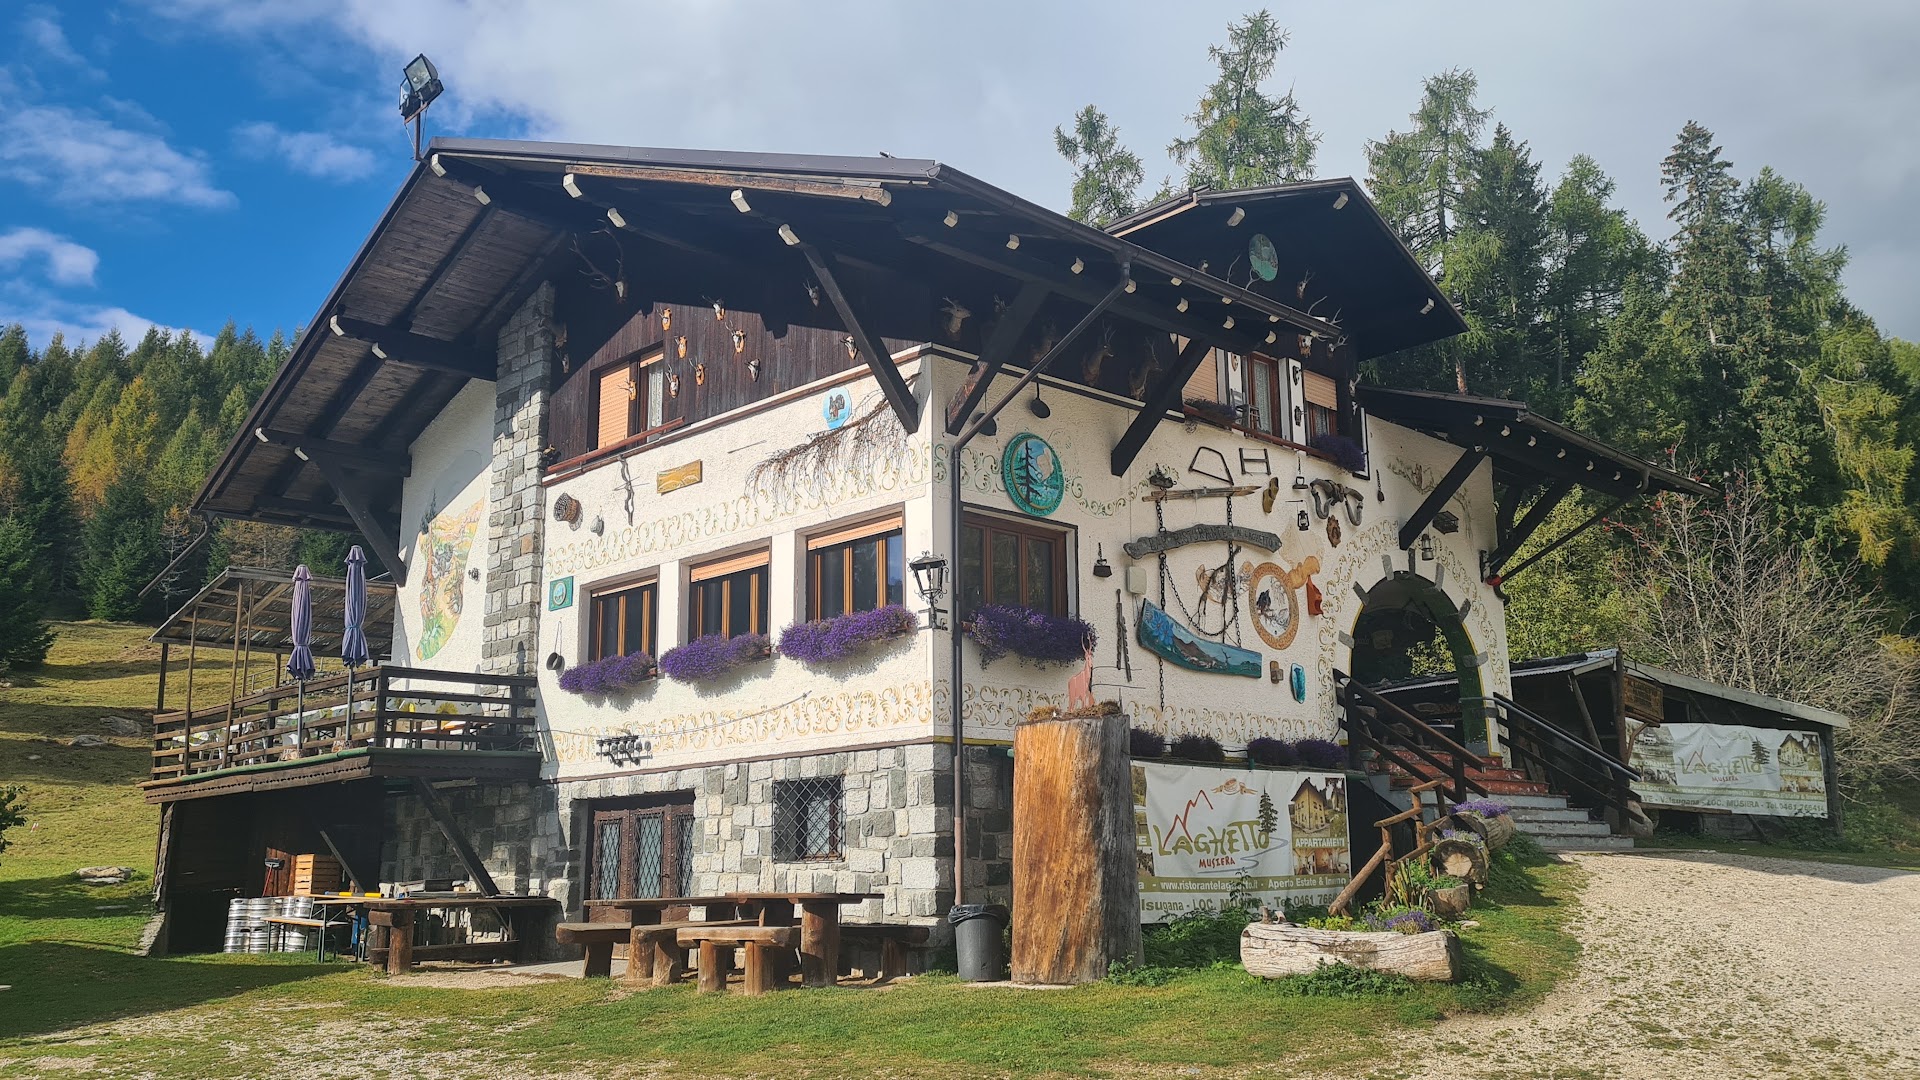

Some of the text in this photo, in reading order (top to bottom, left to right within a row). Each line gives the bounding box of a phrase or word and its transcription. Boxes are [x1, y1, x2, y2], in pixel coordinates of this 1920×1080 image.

[1678, 755, 1763, 775] LAGHETTO
[1153, 820, 1269, 856] LAGHETTO
[1295, 837, 1345, 848] APPARTAMENTI
[1198, 856, 1236, 868] MUSIERA
[1296, 877, 1316, 887] Estate
[1293, 894, 1314, 906] 0461
